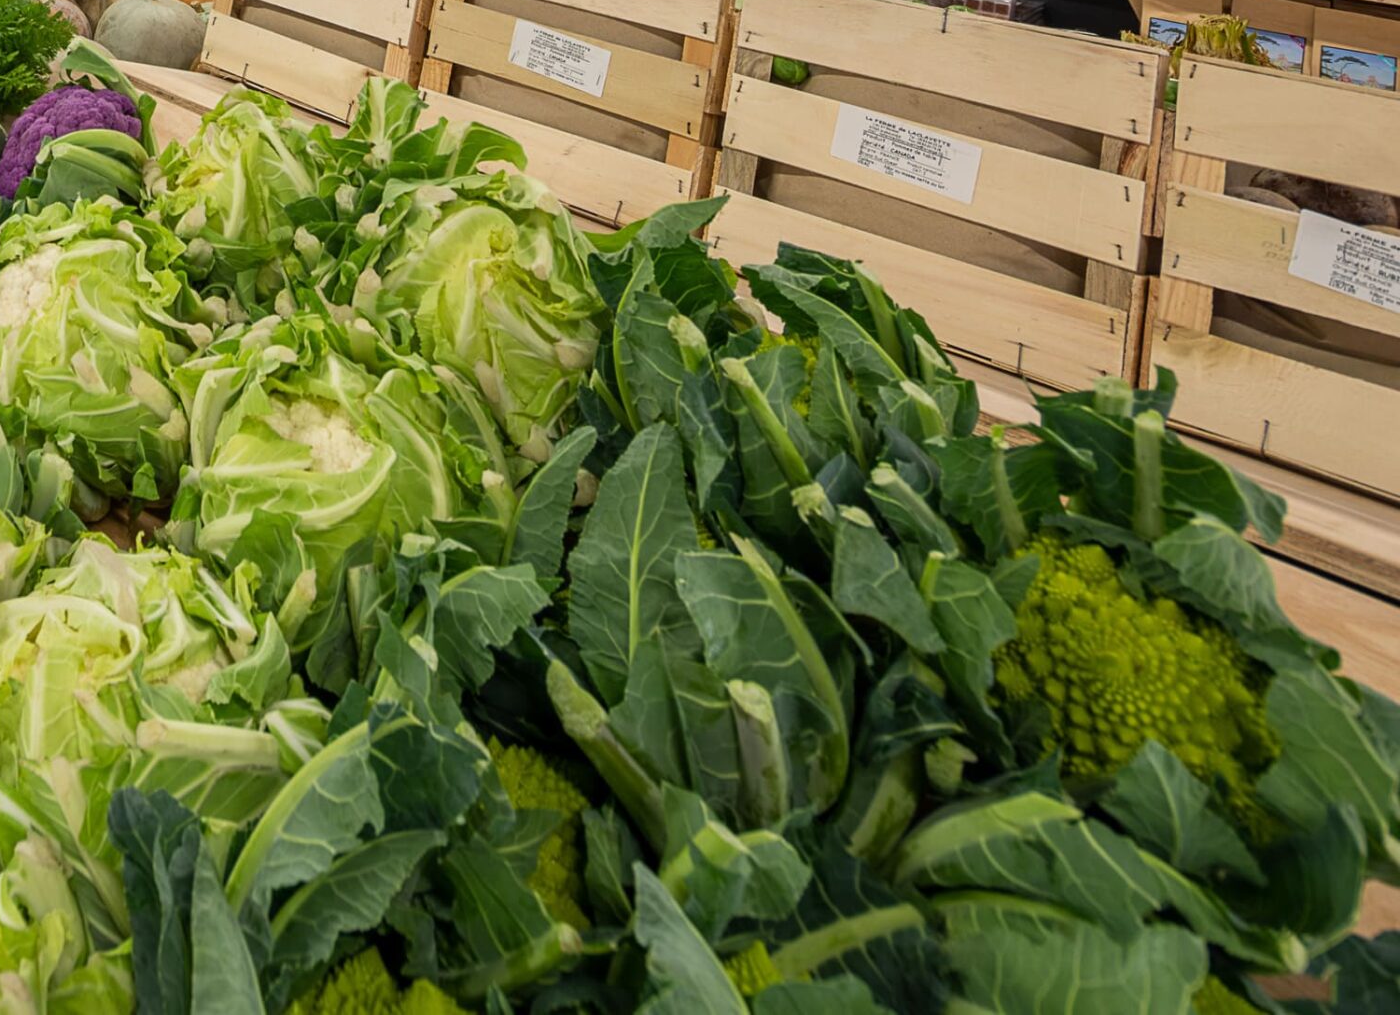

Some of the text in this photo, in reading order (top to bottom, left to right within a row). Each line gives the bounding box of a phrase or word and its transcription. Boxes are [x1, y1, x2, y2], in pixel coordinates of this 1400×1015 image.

[874, 119, 896, 129] FERME
[891, 142, 913, 153] Pommes
[890, 148, 915, 160] CANADA
